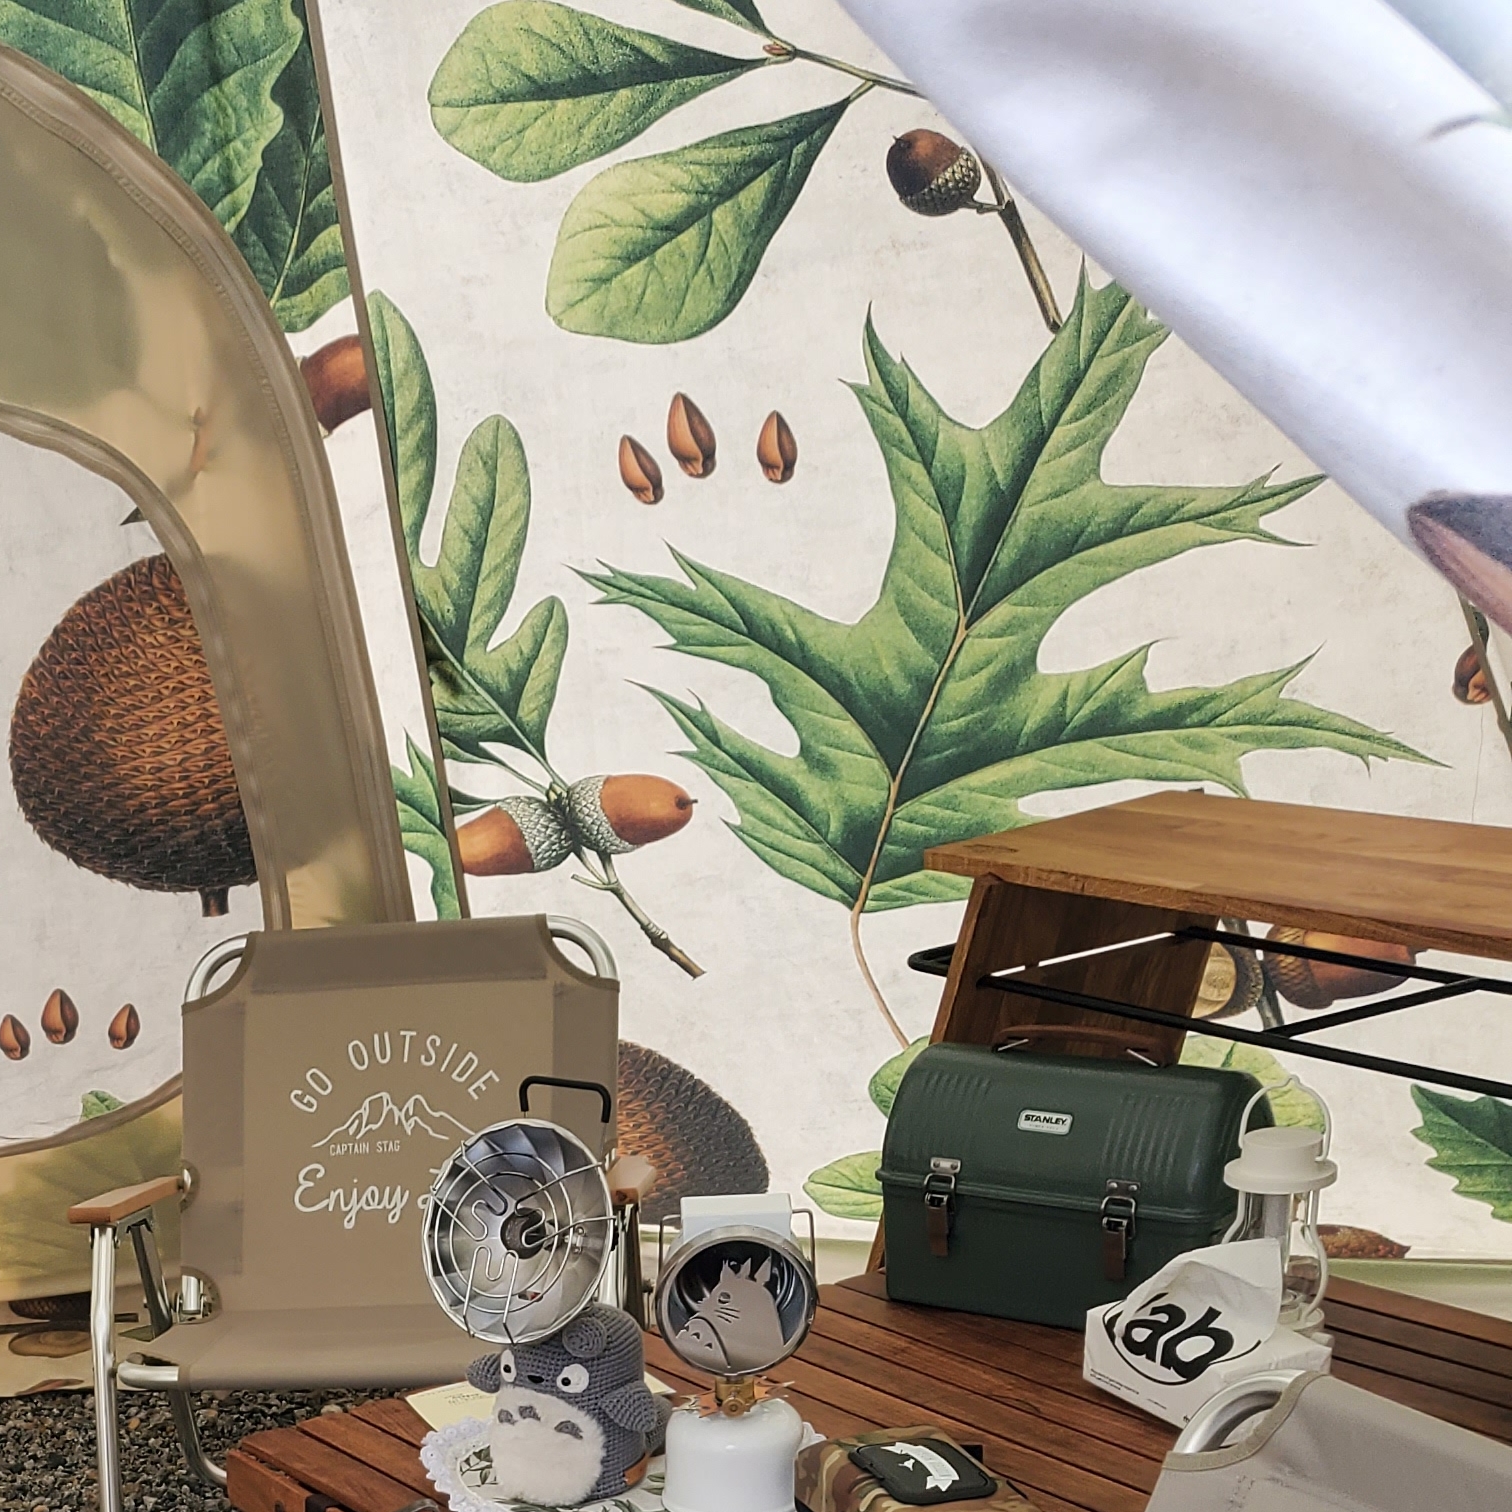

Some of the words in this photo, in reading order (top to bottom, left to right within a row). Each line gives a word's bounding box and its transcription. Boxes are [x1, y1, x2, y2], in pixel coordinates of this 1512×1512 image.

[290, 1067, 333, 1113] GO
[348, 1030, 500, 1101] OUTSIDE
[1024, 1113, 1068, 1126] STANLEY
[329, 1141, 370, 1156] CAPTAIN
[376, 1139, 401, 1153] STAG
[294, 1162, 410, 1230] Enjoy
